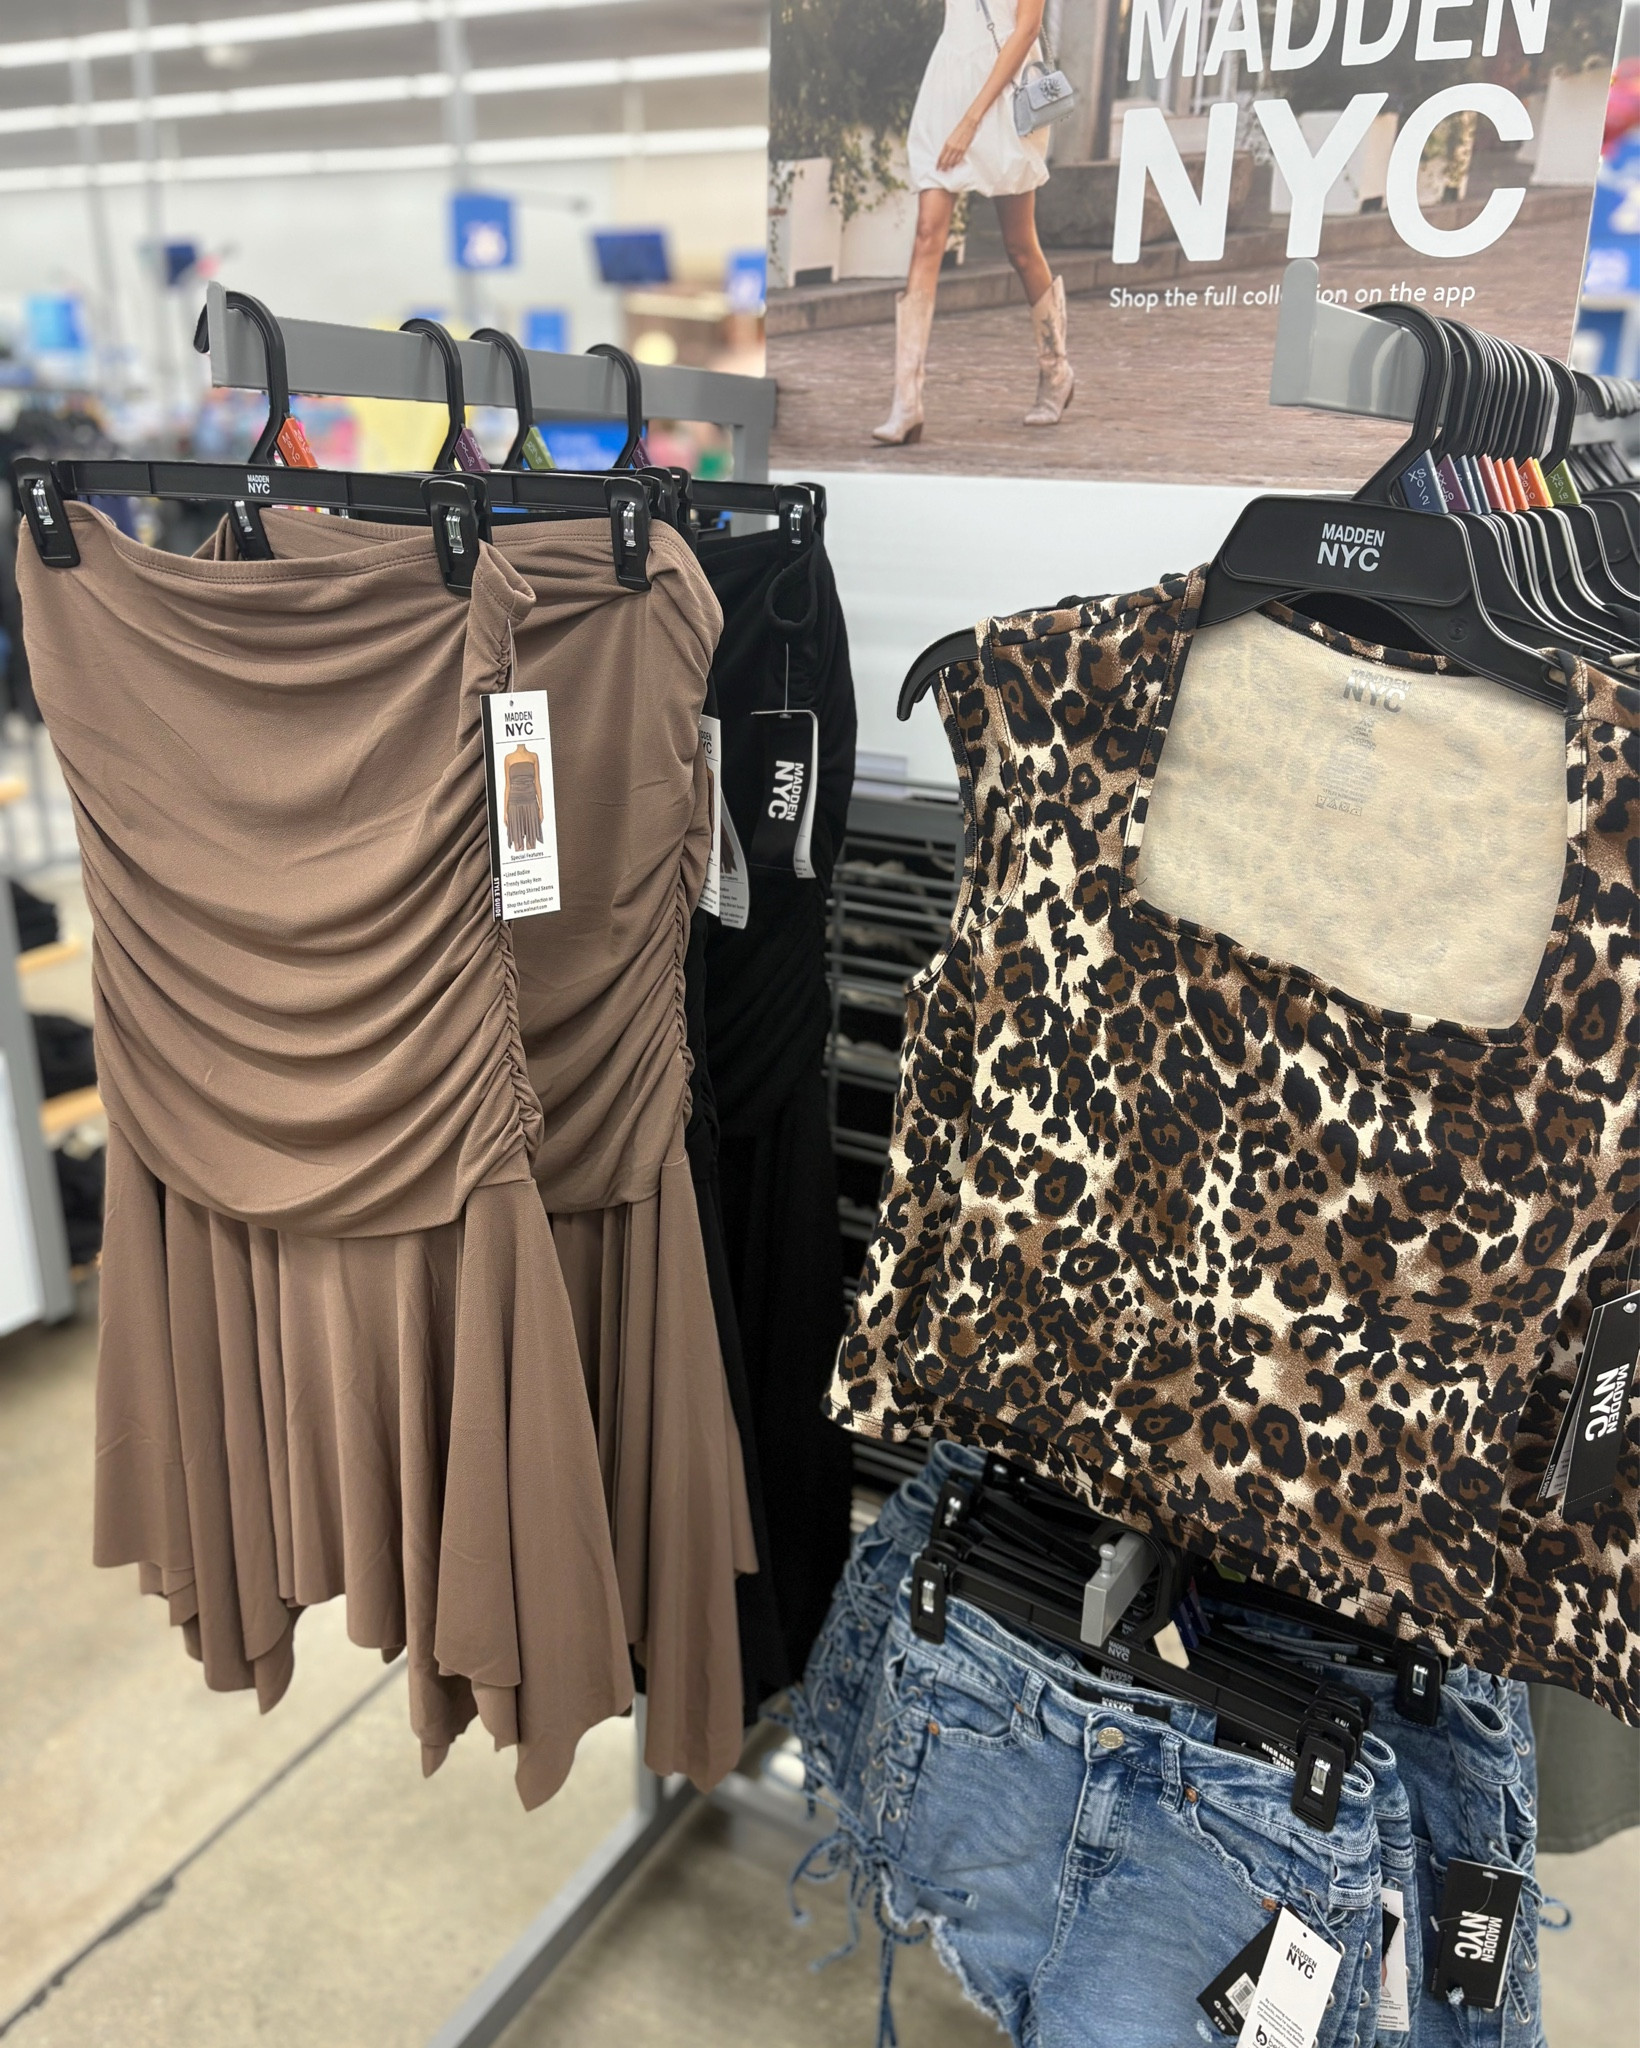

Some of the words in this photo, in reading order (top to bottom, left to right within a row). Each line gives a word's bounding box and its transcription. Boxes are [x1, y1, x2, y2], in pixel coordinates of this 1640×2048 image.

[1127, 0, 1550, 81] MADDEN
[1112, 82, 1534, 264] NYC
[1109, 287, 1159, 312] Shop
[1164, 288, 1197, 306] the
[1203, 285, 1237, 306] full
[1243, 283, 1347, 306] collion
[1354, 287, 1382, 303] on
[1389, 281, 1427, 303] the
[1432, 285, 1475, 307] app
[247, 474, 270, 483] MADDEN
[247, 483, 271, 494] NYC
[1407, 468, 1427, 482] XS
[1321, 522, 1386, 547] MADDEN
[1317, 541, 1380, 572] NYC
[1343, 675, 1406, 713] NYC
[504, 711, 533, 722] MADDEN
[505, 722, 533, 737] NYC
[768, 760, 795, 820] NYC
[786, 763, 804, 821] MADDEN
[1585, 1368, 1619, 1441] NYC
[1606, 1363, 1630, 1435] MADDEN
[1107, 1646, 1130, 1663] NYC
[1454, 1911, 1490, 1960] NYC
[1481, 1916, 1503, 1963] MADDEN
[1286, 1949, 1315, 1979] NYC
[1290, 1942, 1317, 1968] MADDEN
